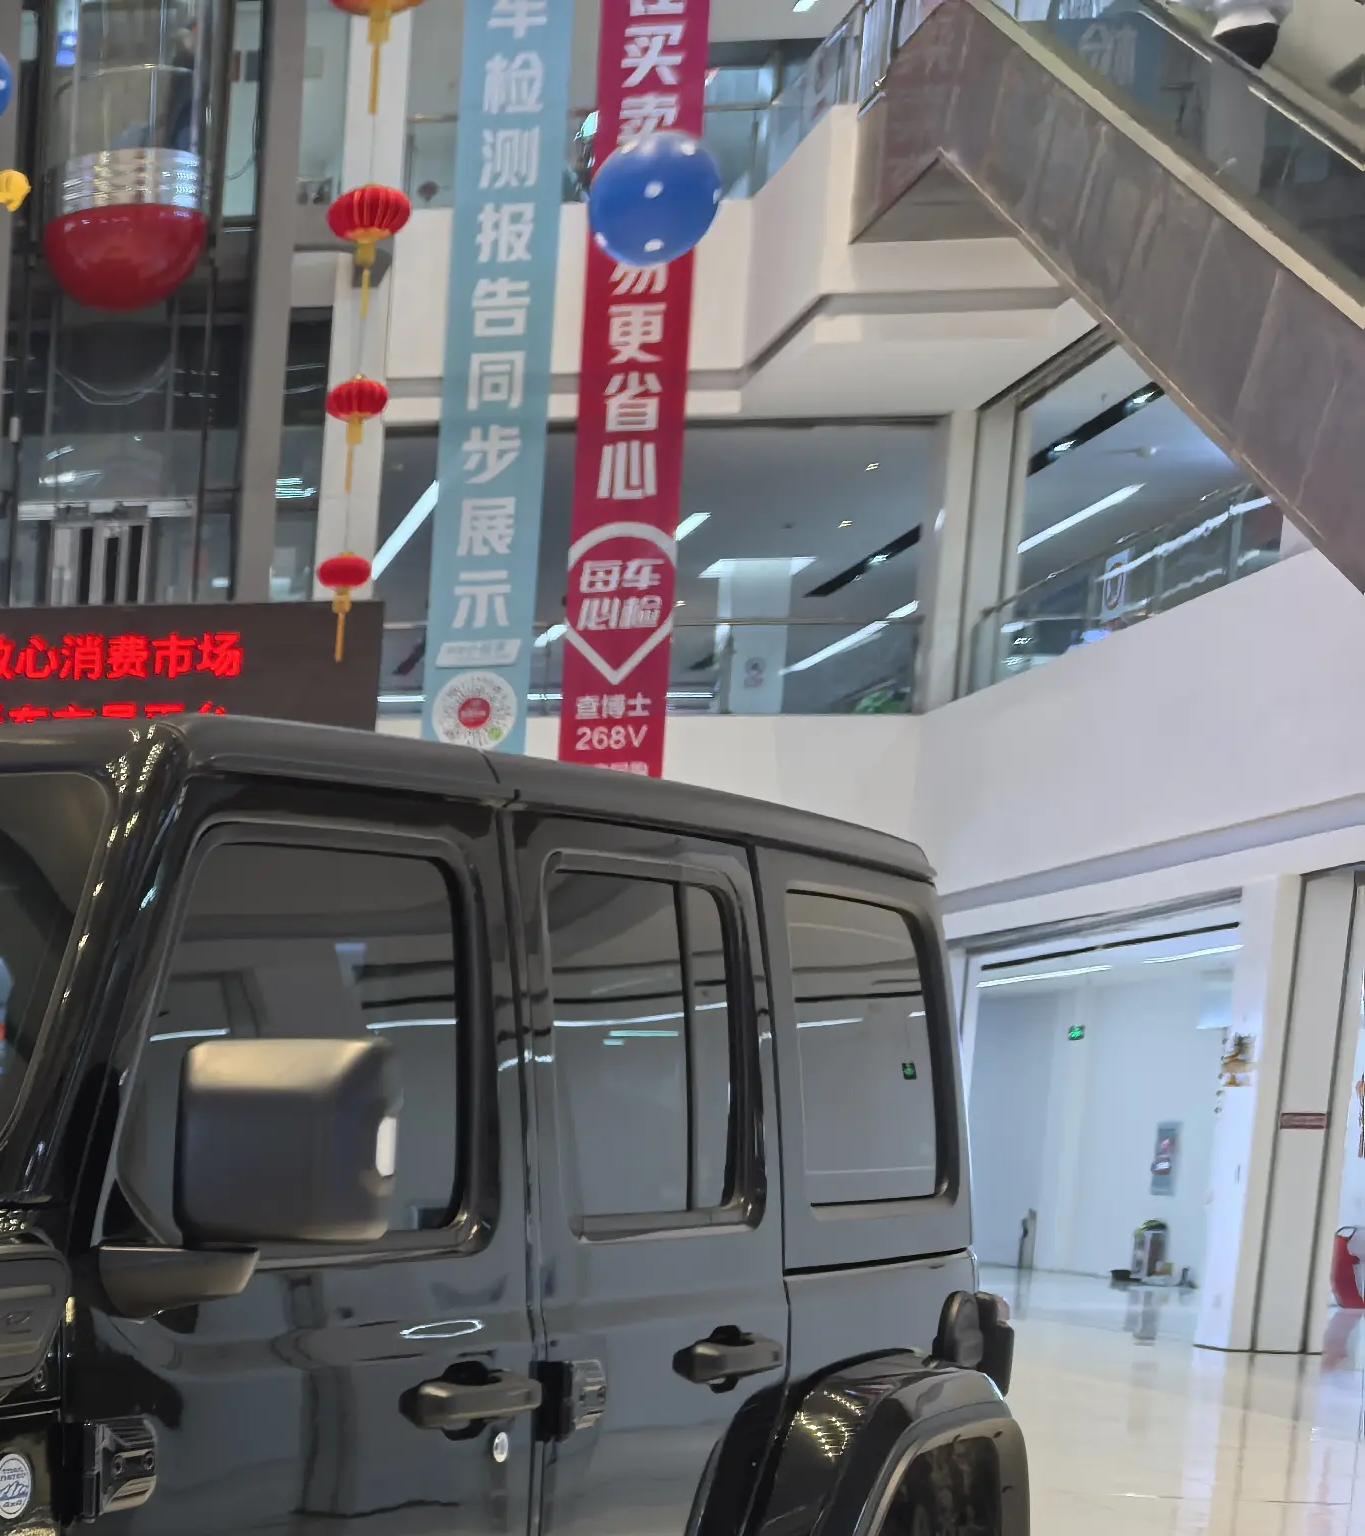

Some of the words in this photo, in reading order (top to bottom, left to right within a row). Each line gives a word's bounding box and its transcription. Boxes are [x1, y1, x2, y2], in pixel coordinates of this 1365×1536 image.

[596, 0, 687, 500] 买卖易更省心
[579, 558, 665, 593] 每车
[577, 594, 663, 630] 必检
[575, 693, 652, 720] 查博士
[575, 724, 649, 751] 268V
